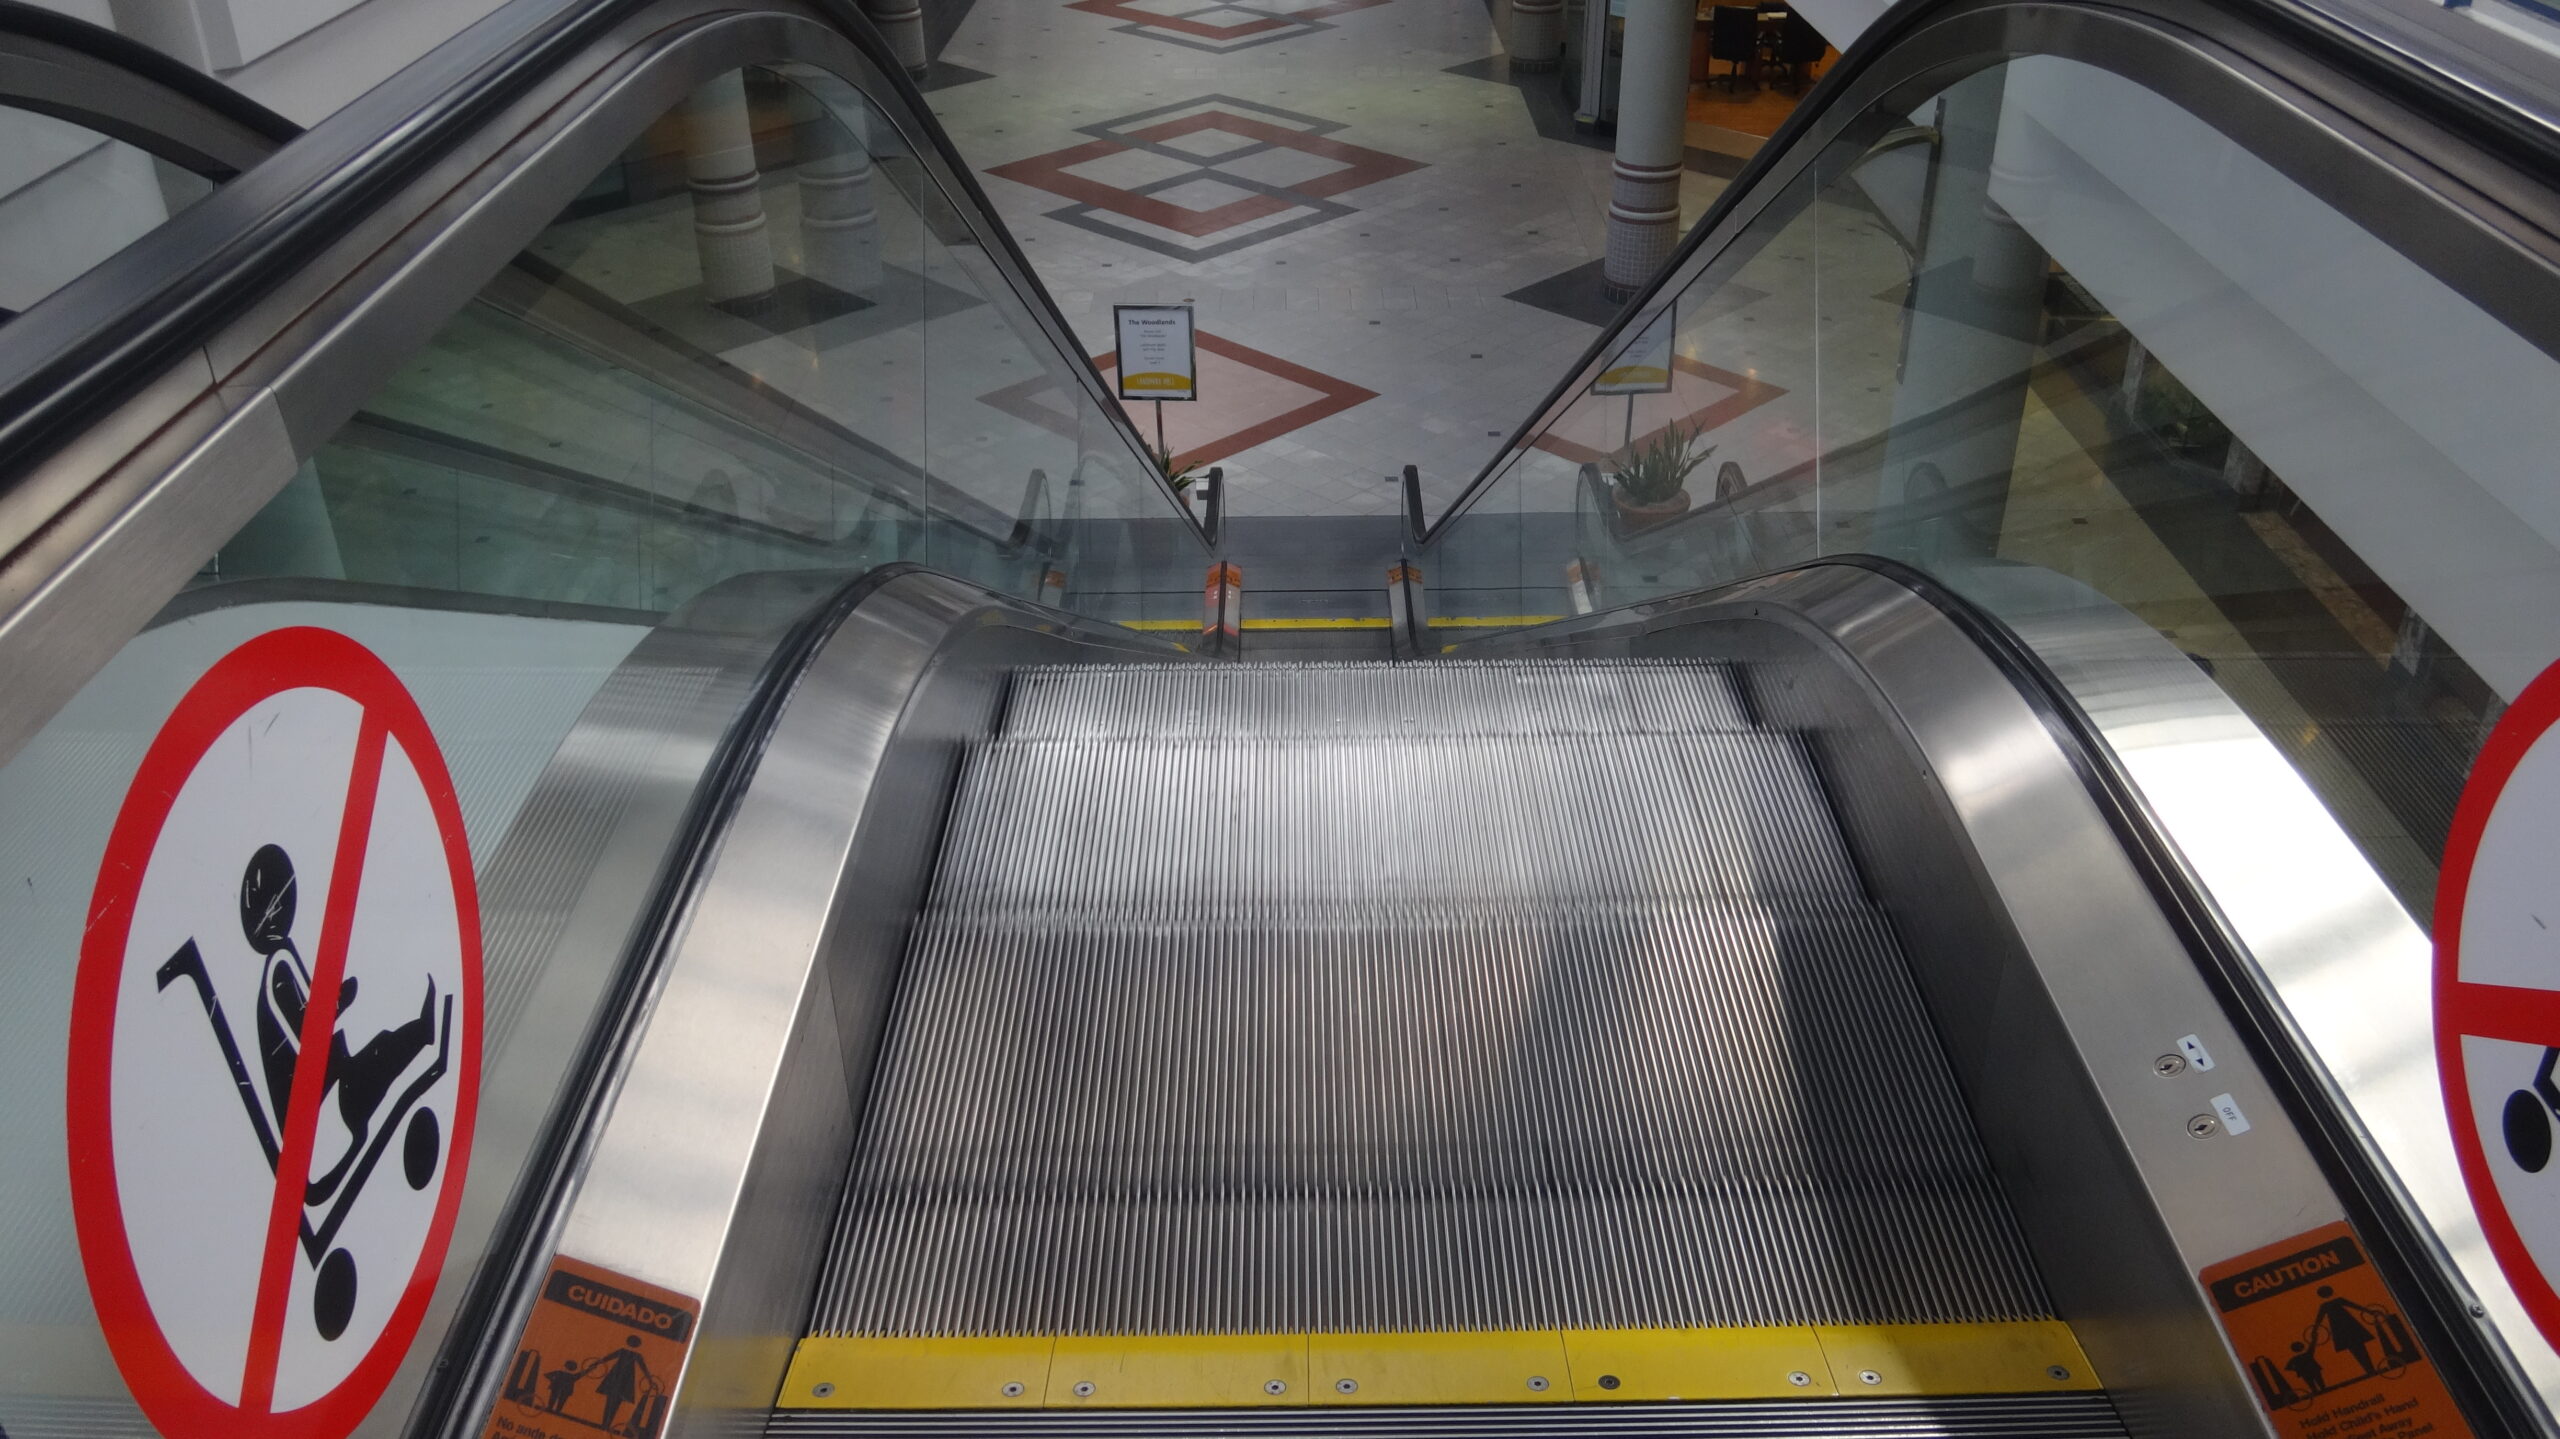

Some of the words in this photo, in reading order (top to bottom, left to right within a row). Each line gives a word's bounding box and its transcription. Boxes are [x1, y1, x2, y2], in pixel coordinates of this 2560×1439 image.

[2222, 1106, 2237, 1121] OFF
[2234, 1250, 2341, 1298] CAUTION
[567, 1285, 673, 1330] CUIDADO
[496, 1416, 514, 1431] No
[2299, 1410, 2330, 1429] Hold
[2332, 1393, 2385, 1418] Handrail
[2339, 1410, 2383, 1432] Child's
[2384, 1396, 2419, 1416] Hand
[2378, 1415, 2413, 1434] Away
